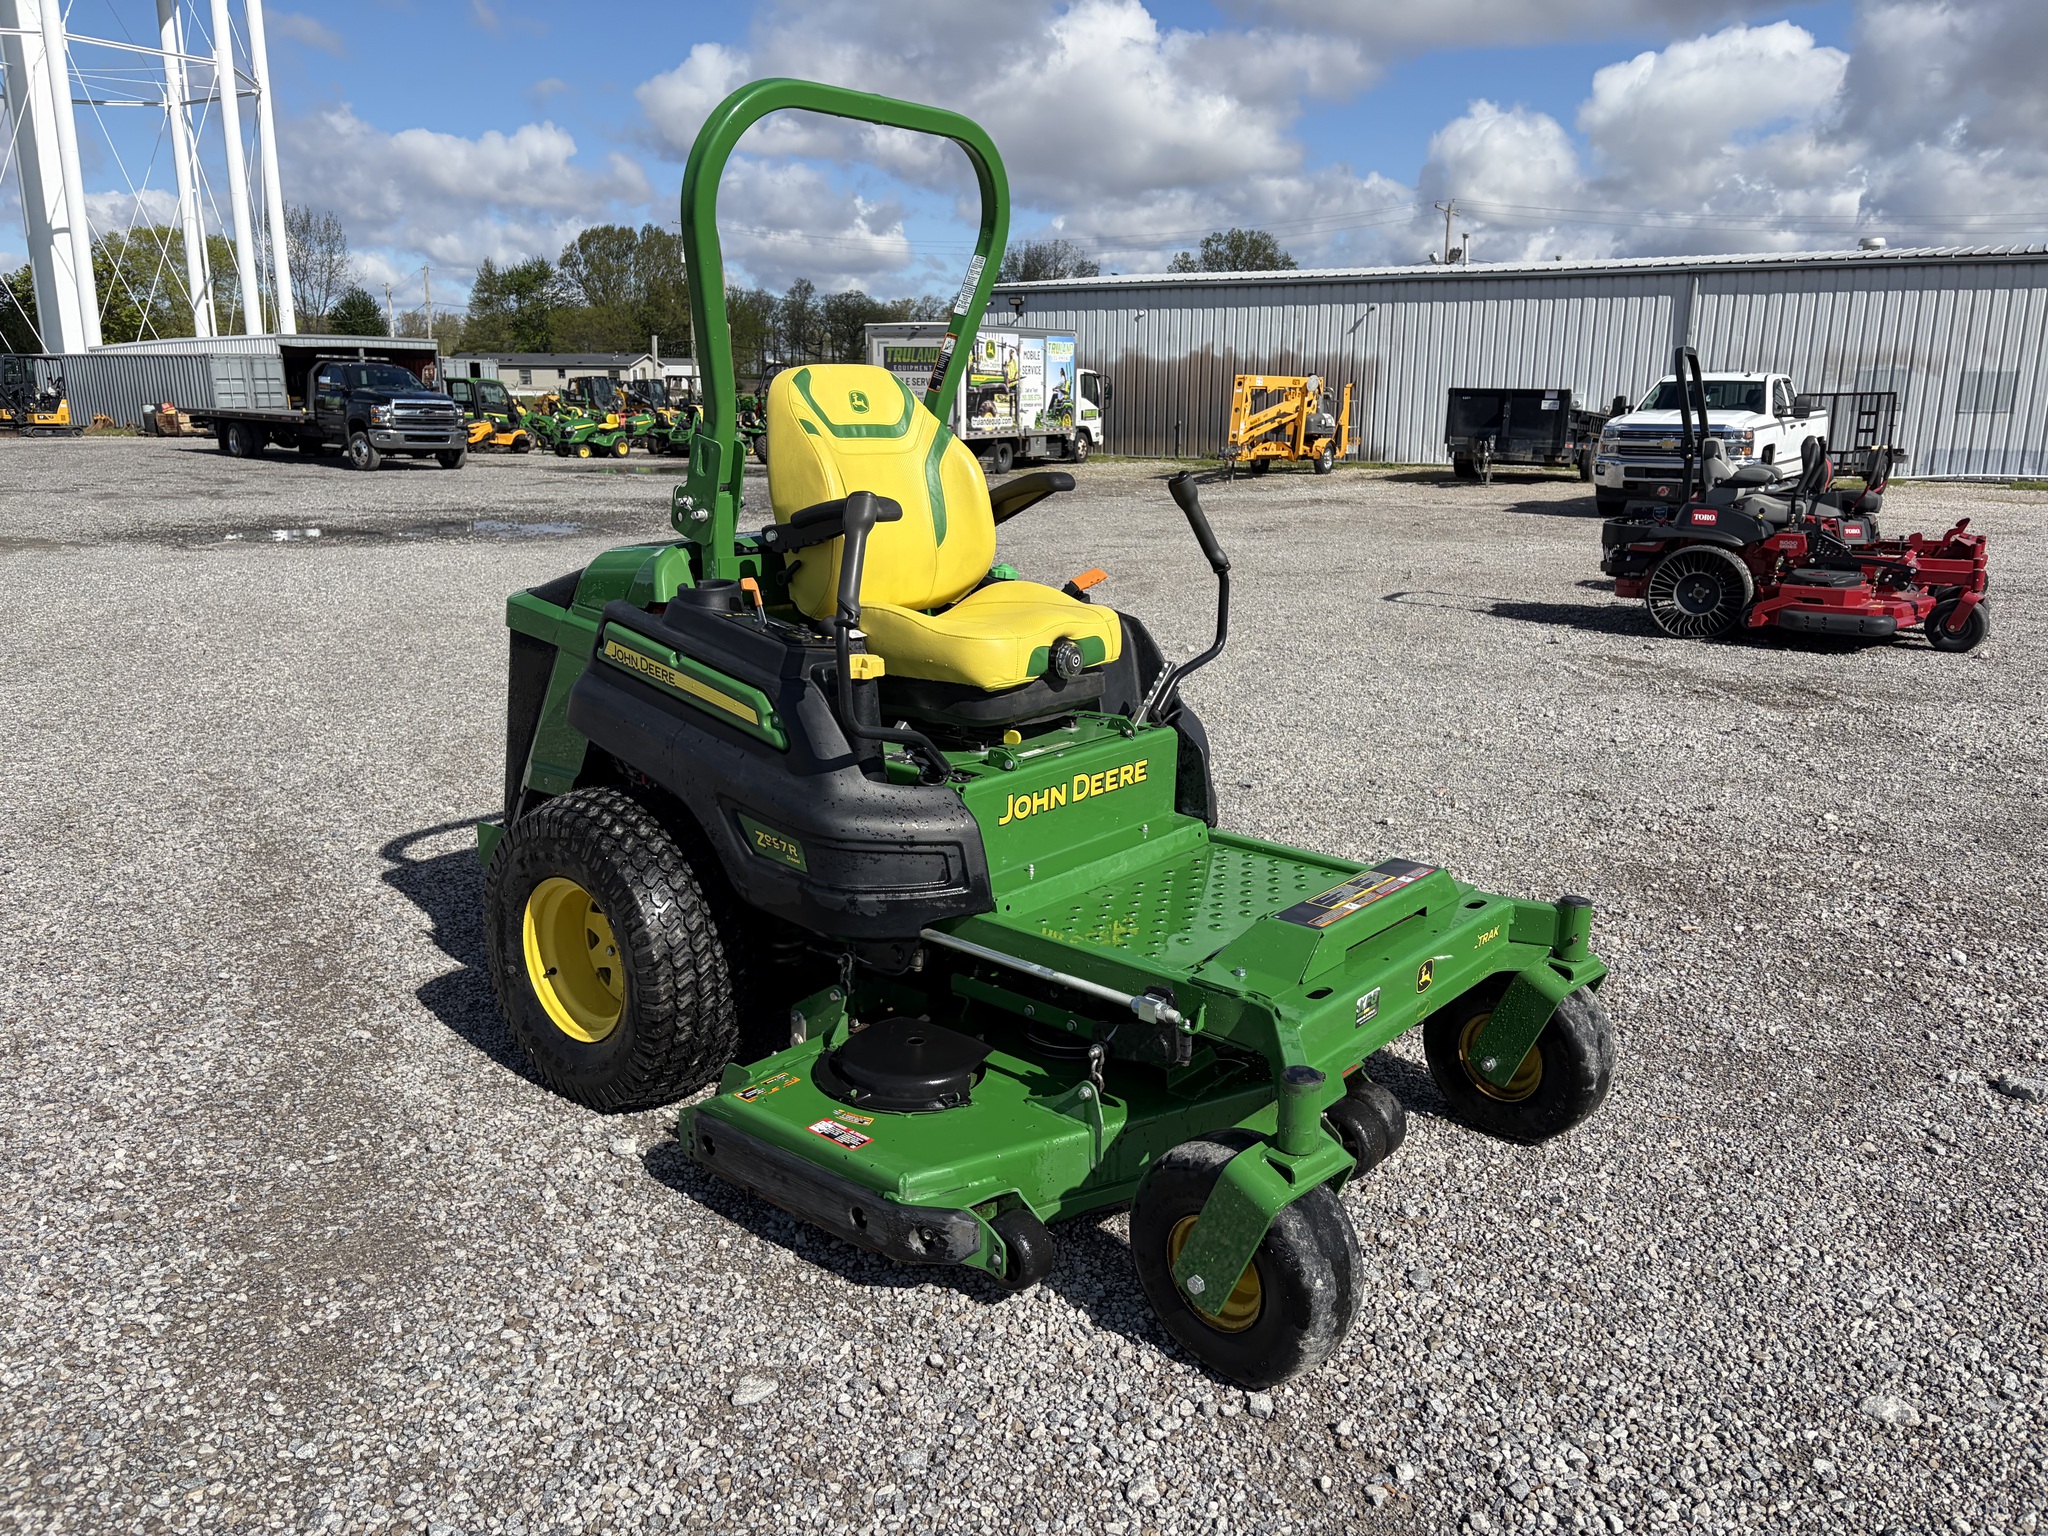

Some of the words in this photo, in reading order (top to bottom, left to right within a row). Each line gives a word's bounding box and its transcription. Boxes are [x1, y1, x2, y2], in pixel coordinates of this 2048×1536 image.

[886, 347, 940, 363] TRULAND
[1023, 350, 1041, 361] MOBILE
[1022, 365, 1042, 375] SERVICE
[972, 417, 1012, 427] trulandequip.com
[1693, 513, 1716, 522] TORO
[611, 645, 638, 667] JOHN
[640, 657, 676, 685] DEERE
[998, 782, 1067, 826] JOHN
[1072, 758, 1148, 803] DEERE
